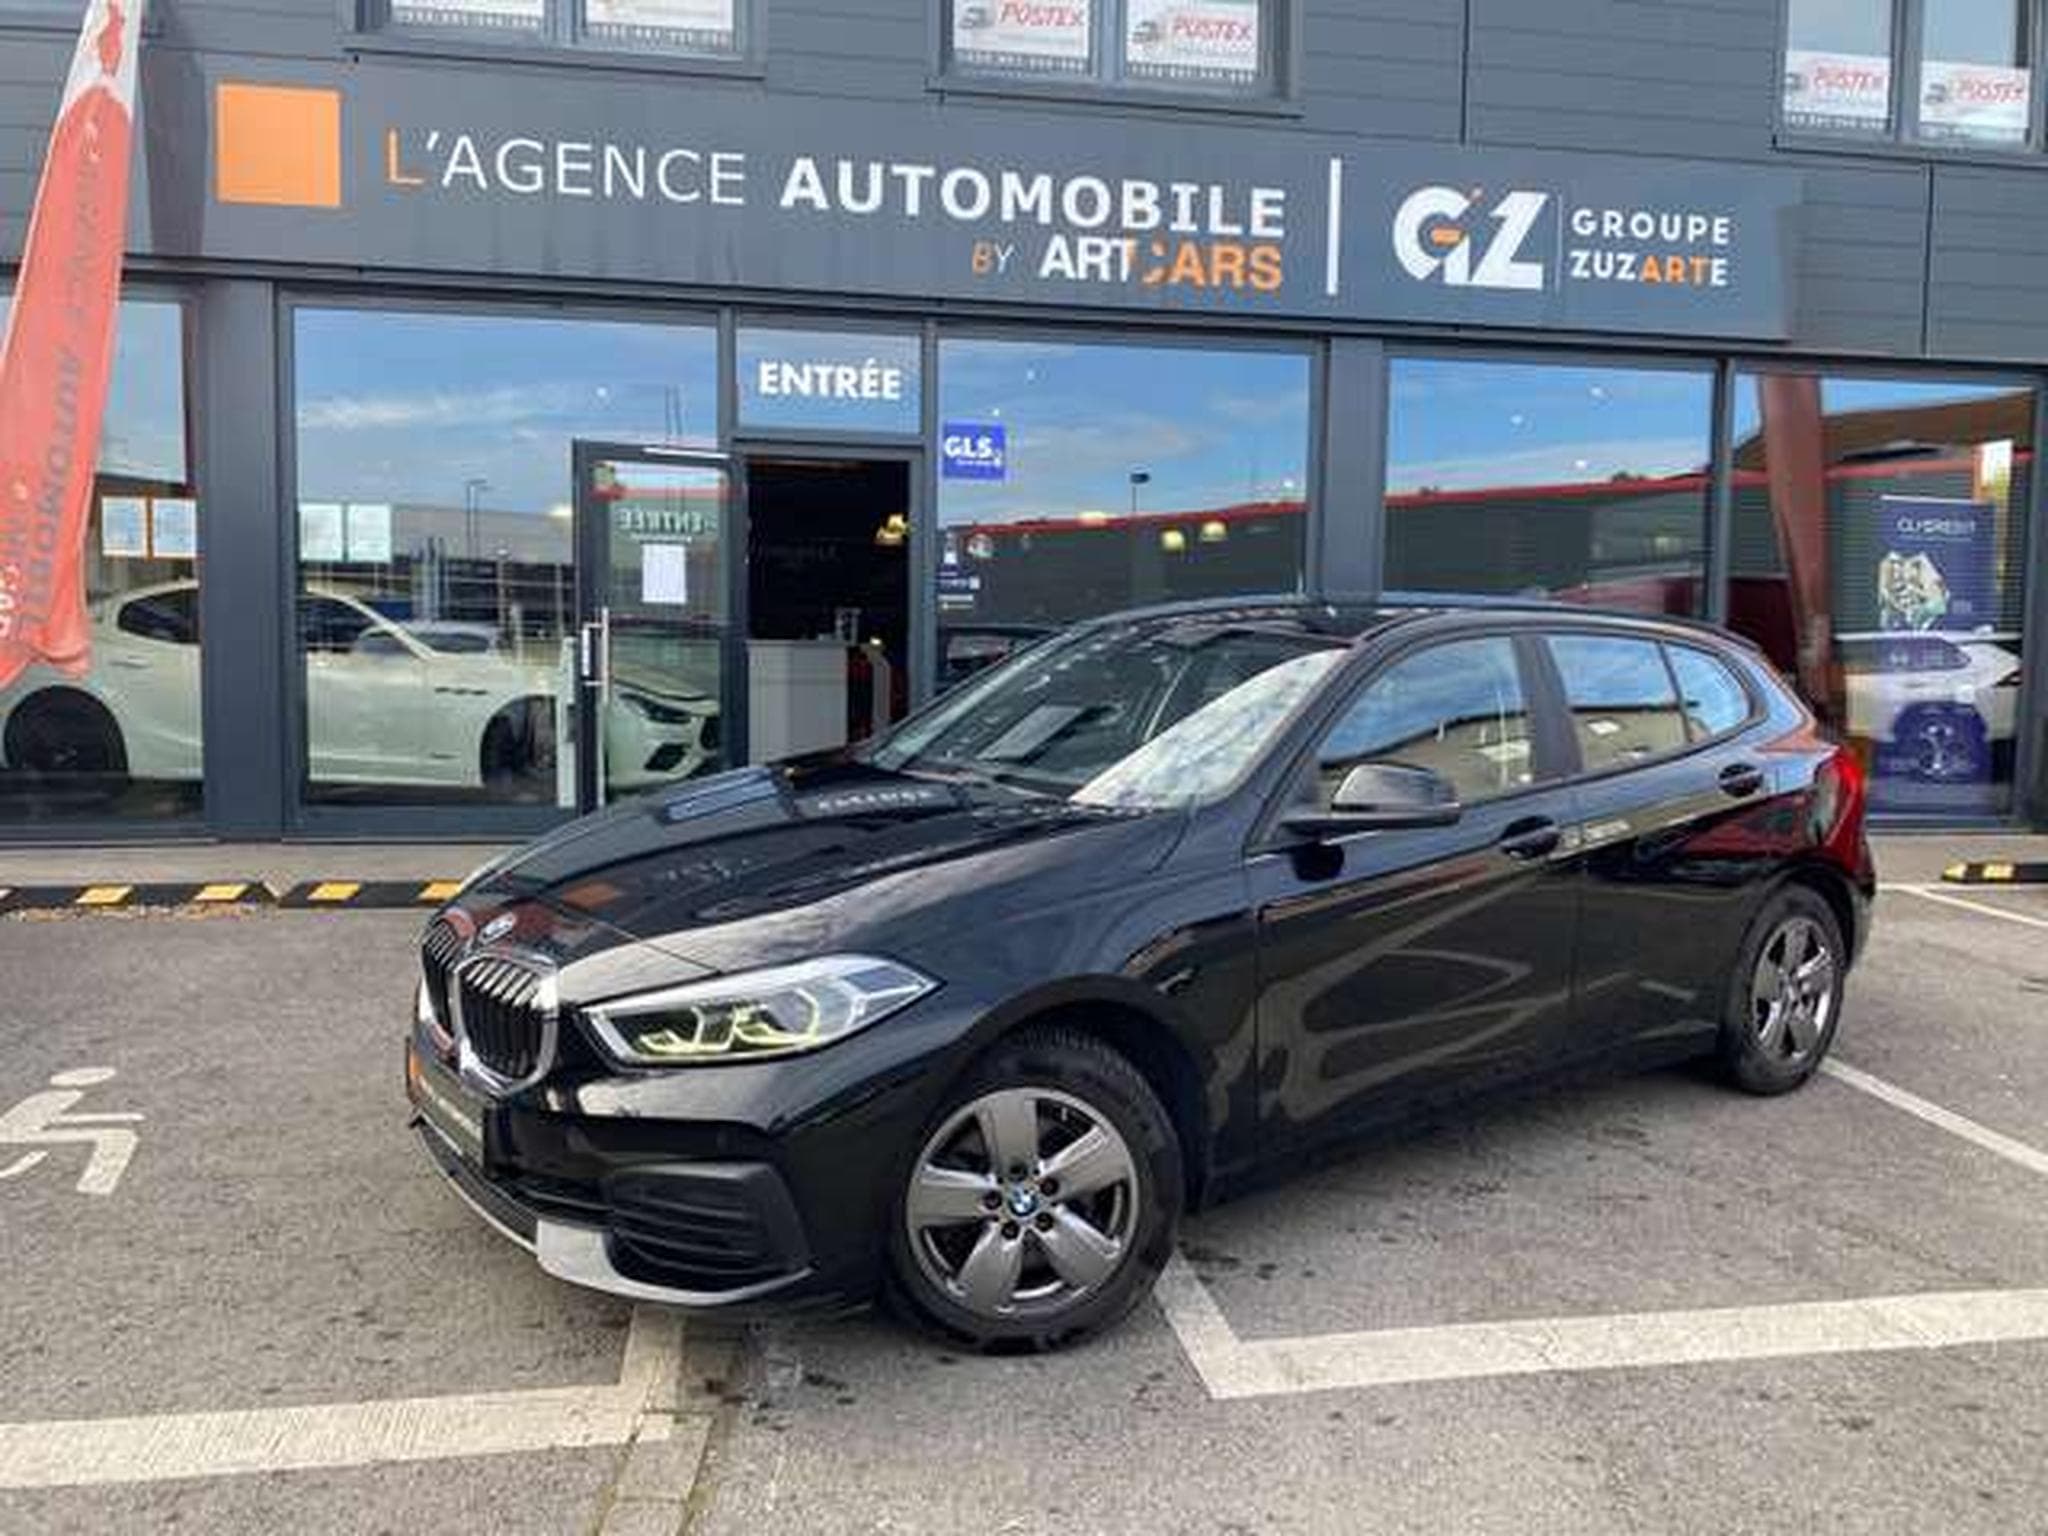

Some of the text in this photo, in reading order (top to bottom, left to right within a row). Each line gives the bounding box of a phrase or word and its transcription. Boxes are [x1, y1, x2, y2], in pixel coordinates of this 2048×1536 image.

[384, 129, 1286, 239] L'AGENCE AUTOMOBILE
[1571, 208, 1730, 245] GROUPE
[971, 242, 1015, 275] BY
[1570, 250, 1728, 287] ZUZARTE
[758, 358, 902, 401] ENTRÉE
